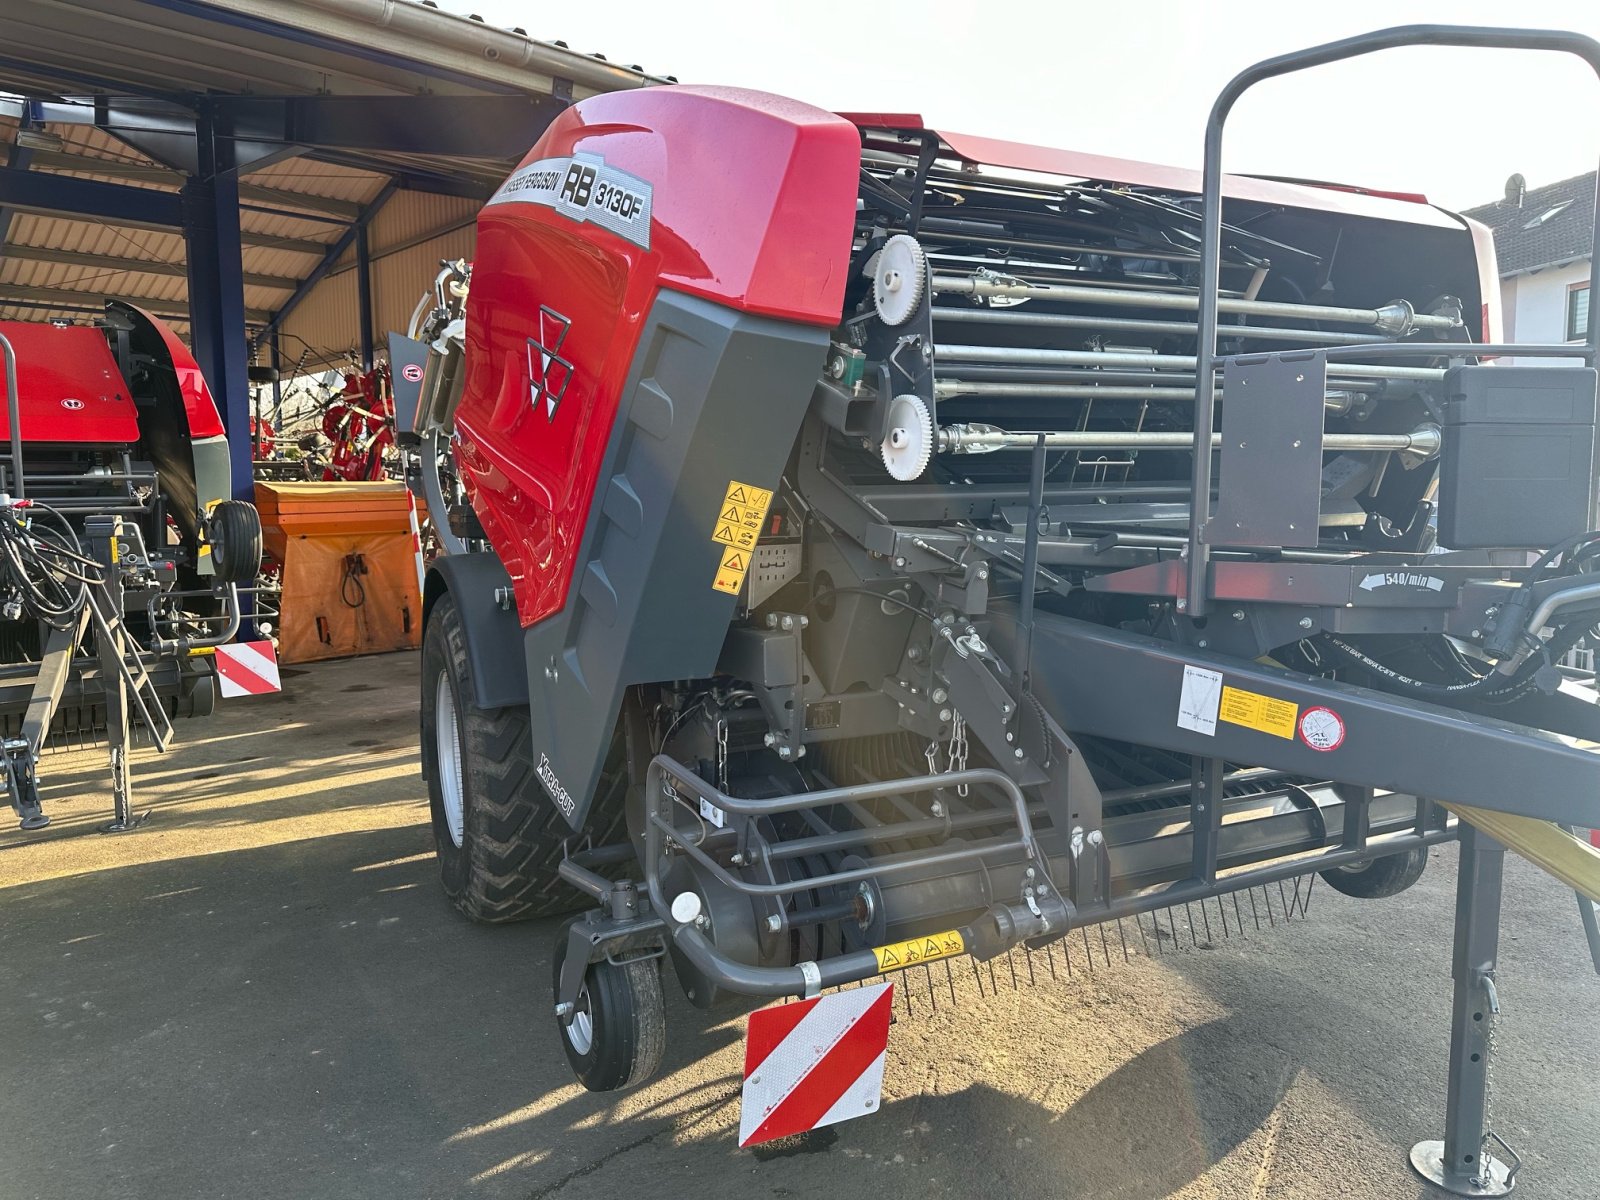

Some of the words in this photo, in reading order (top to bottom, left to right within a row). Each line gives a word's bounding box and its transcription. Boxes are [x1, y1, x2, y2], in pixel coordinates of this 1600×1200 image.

[525, 171, 562, 191] FERGUSON
[560, 163, 596, 207] RB
[595, 183, 644, 220] 3130F
[1385, 572, 1428, 587] 540/min
[1349, 648, 1362, 659] BAR
